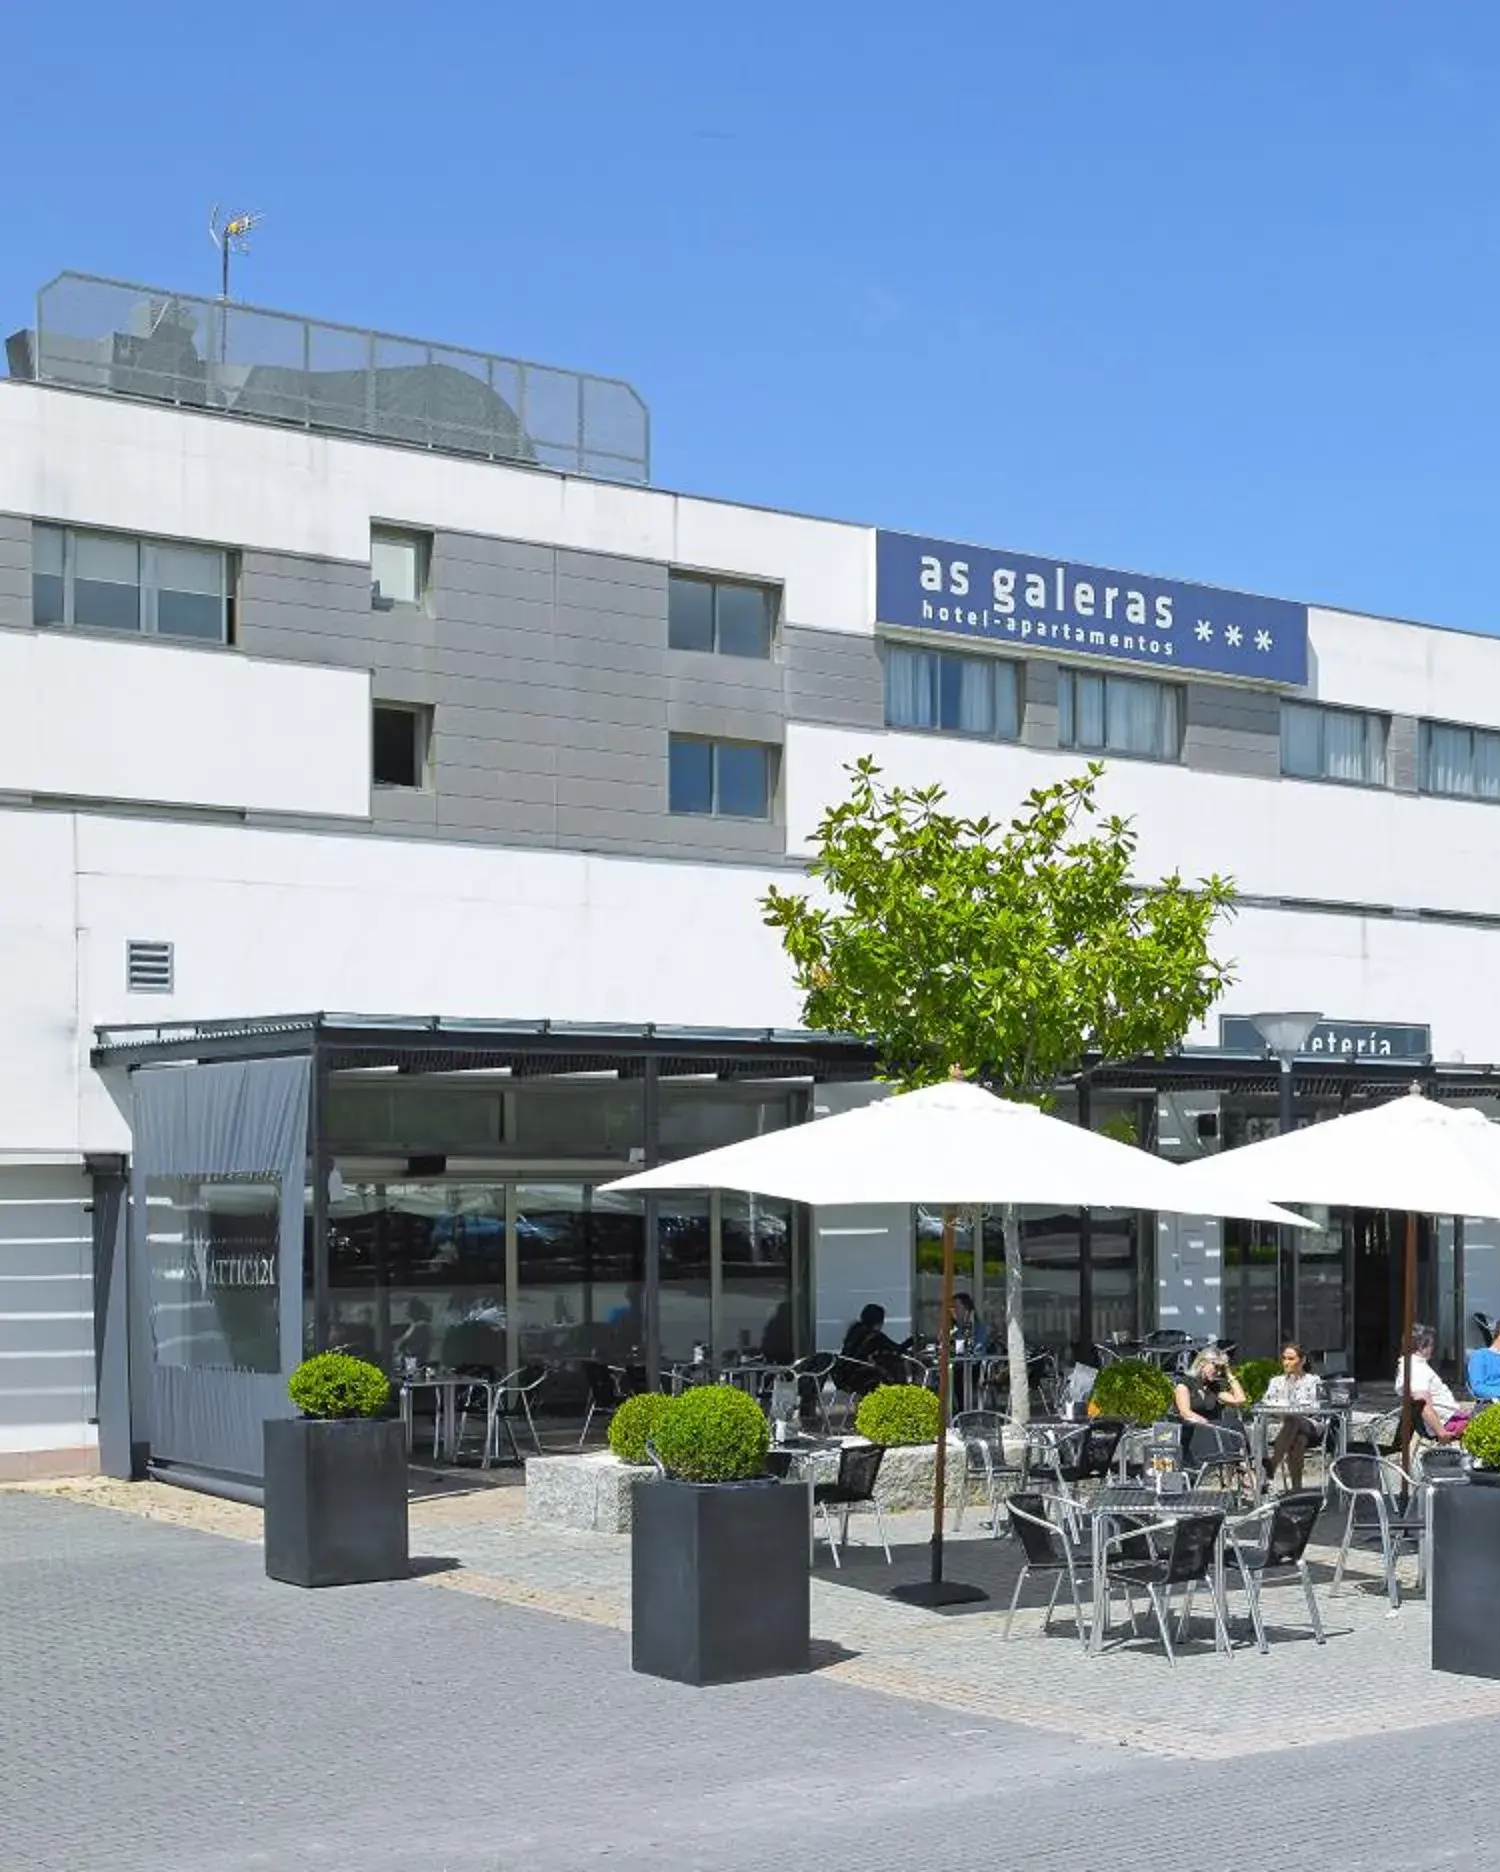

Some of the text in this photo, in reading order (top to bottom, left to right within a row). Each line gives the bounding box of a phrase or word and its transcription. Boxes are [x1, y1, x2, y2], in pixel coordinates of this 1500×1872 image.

[920, 555, 1173, 629] as galeras
[922, 599, 1173, 655] hotel-apartamentos
[1265, 1030, 1391, 1055] etería
